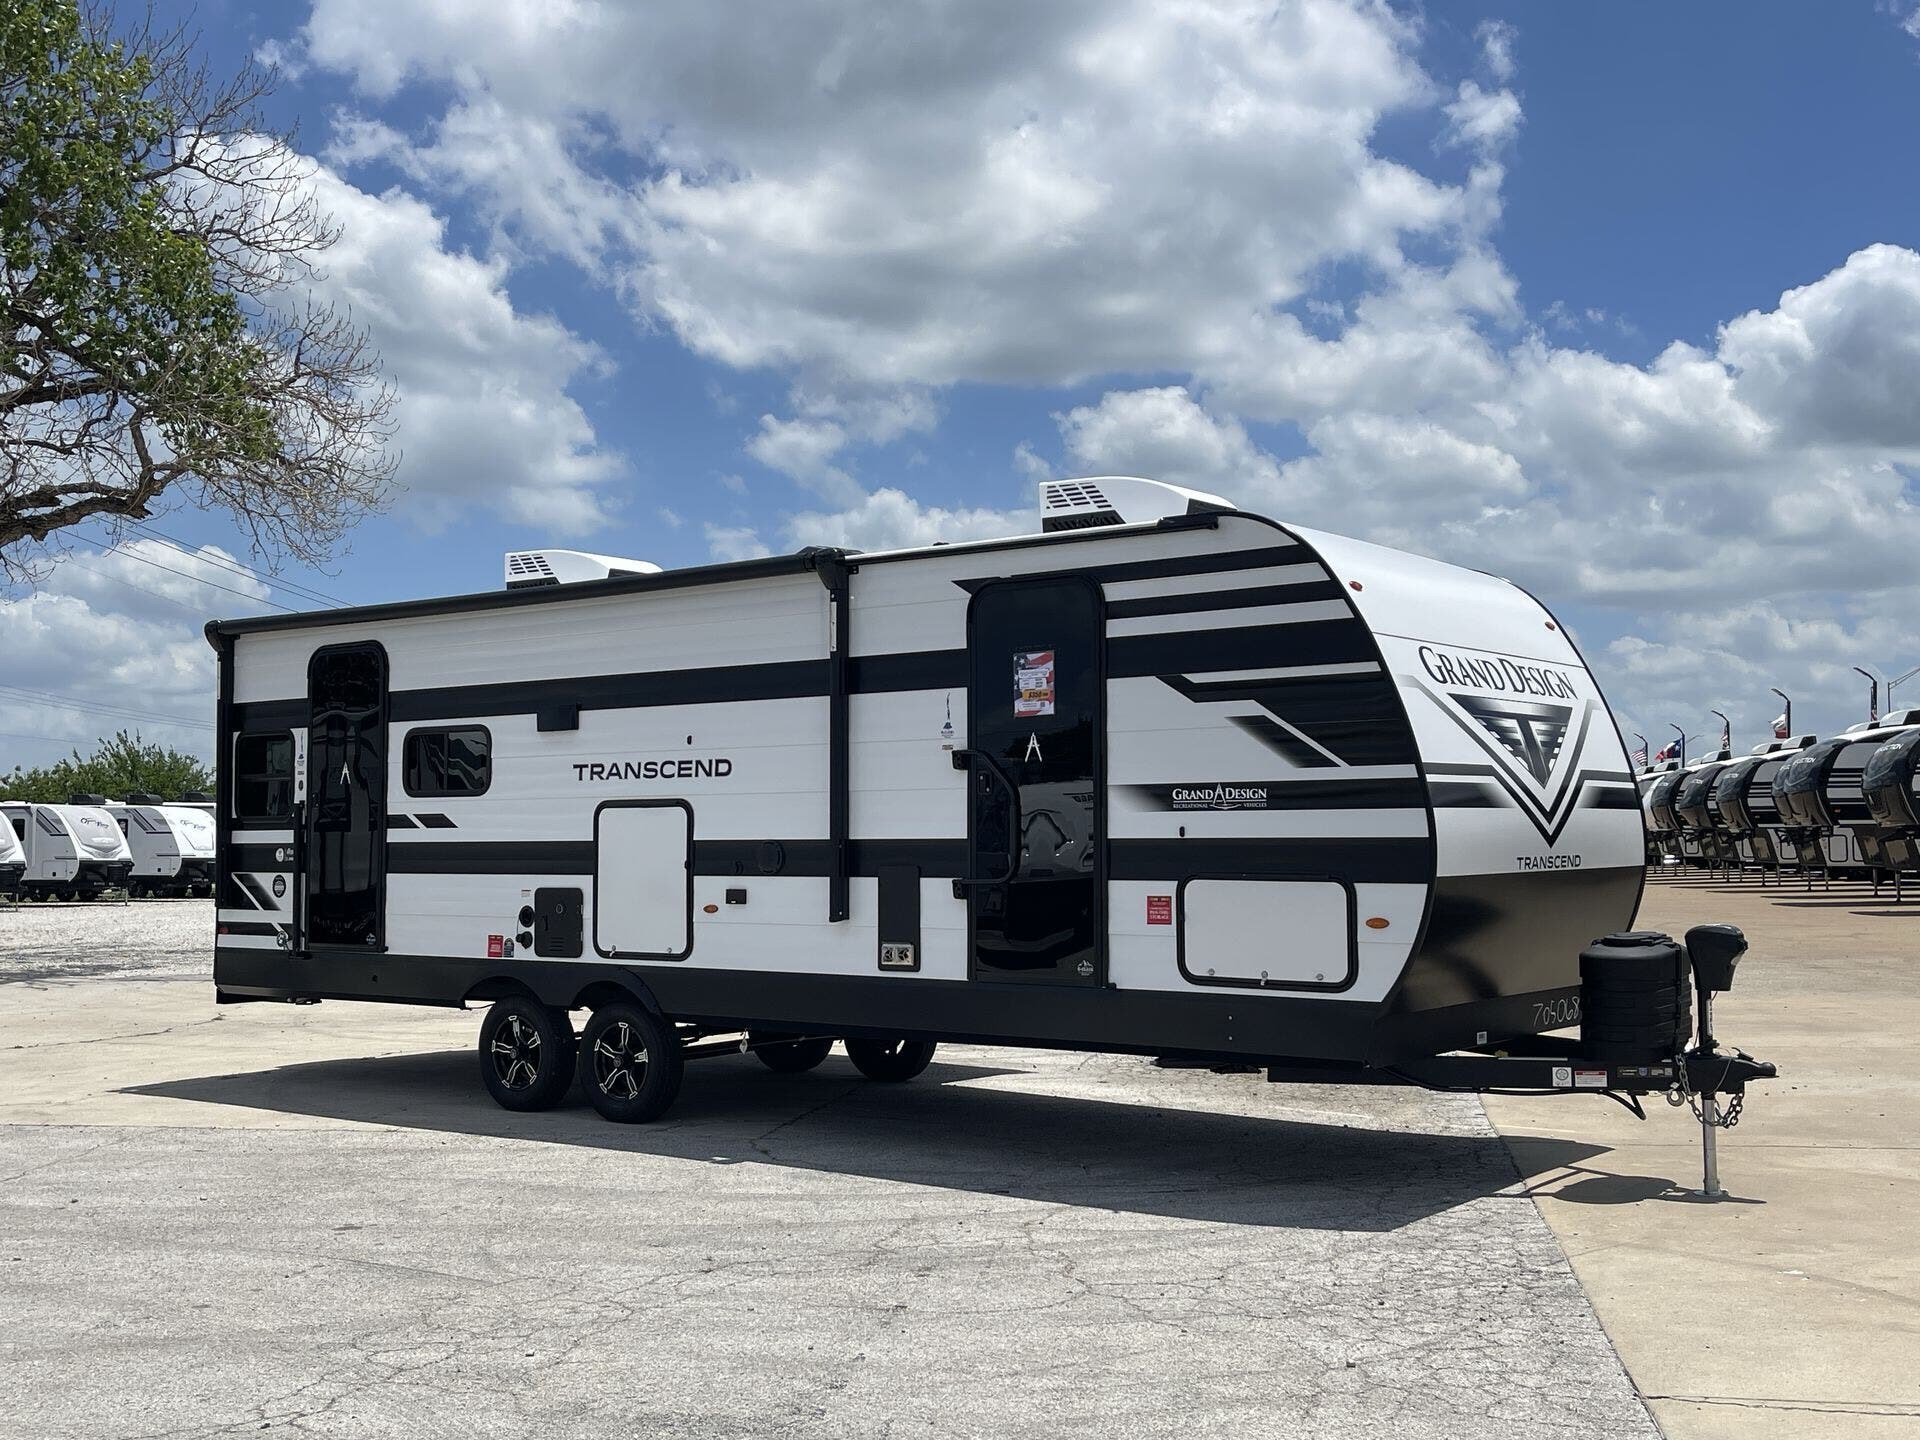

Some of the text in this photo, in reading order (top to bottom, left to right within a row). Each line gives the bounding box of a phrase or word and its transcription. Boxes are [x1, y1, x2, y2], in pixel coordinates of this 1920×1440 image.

[1418, 645, 1579, 701] GRAND DESIGN
[572, 758, 733, 781] TRANSCEND
[1172, 787, 1267, 800] GRAND DESIGN
[1516, 854, 1582, 871] TRANSCEND
[1532, 995, 1581, 1027] 705068
